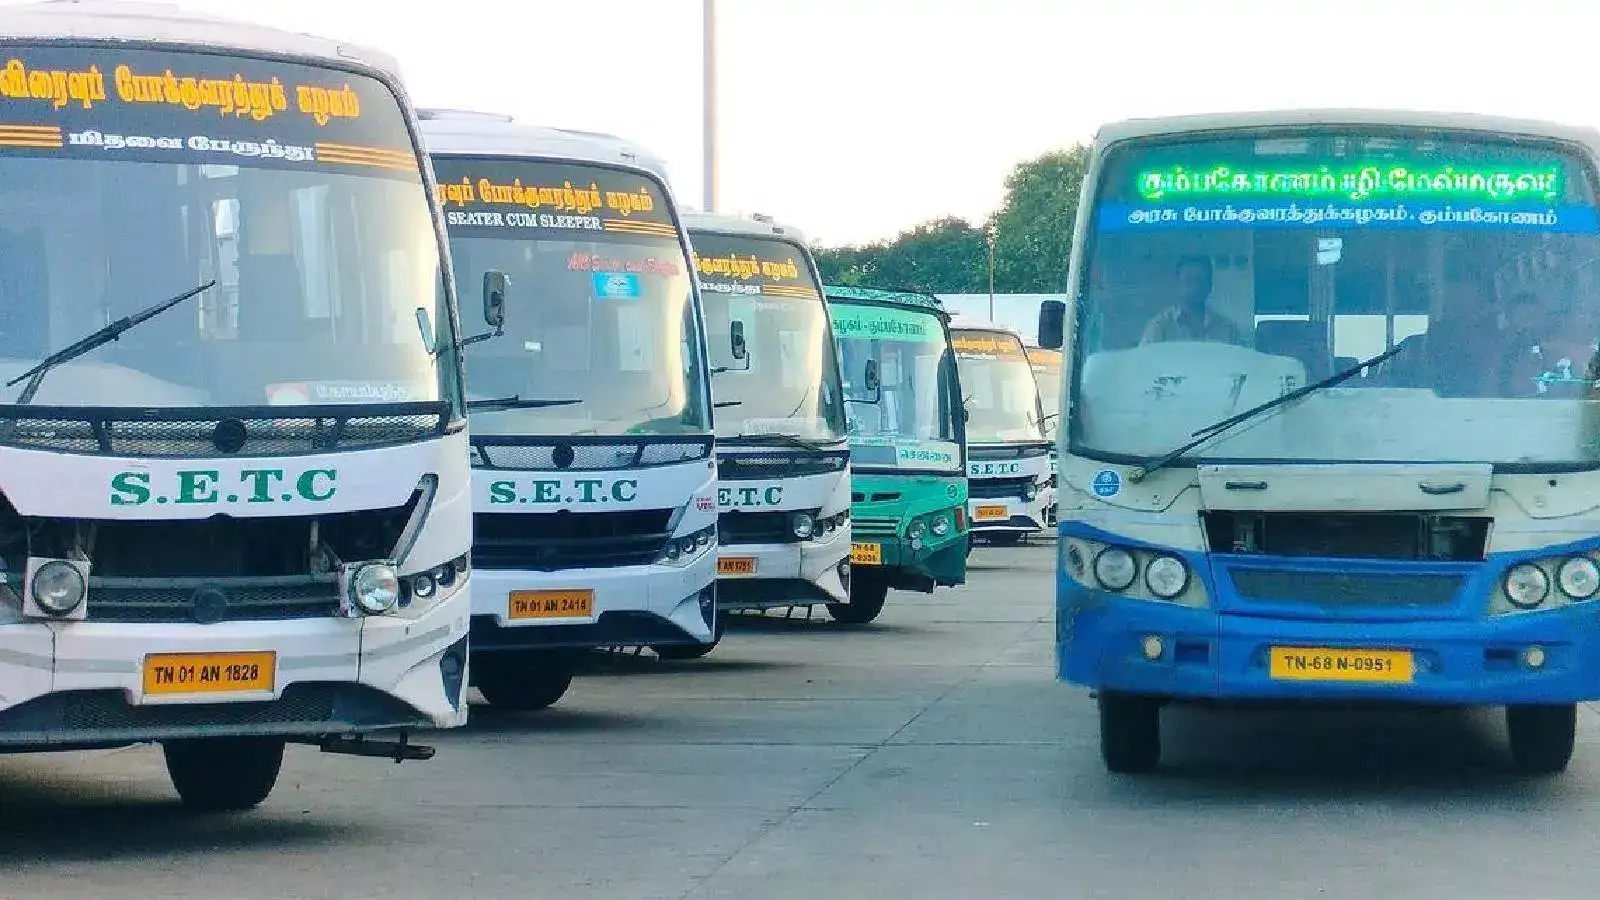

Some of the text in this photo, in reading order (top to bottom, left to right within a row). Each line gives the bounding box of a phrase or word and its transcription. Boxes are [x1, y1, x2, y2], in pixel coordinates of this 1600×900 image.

[115, 64, 287, 121] போக்குவரத்துக்
[296, 82, 360, 126] கழகம்
[448, 212, 602, 231] SEATER CUM SLEEPER
[1128, 207, 1177, 223] அரசு
[110, 469, 338, 505] S.E.T.C
[490, 479, 638, 503] S.E.T.C
[717, 486, 784, 506] E.T.C
[515, 600, 528, 613] TN
[530, 600, 541, 612] 01
[544, 599, 558, 611] AN
[1285, 655, 1392, 672] TN-68 N-0951
[154, 664, 259, 683] TN 01 AN 1828
